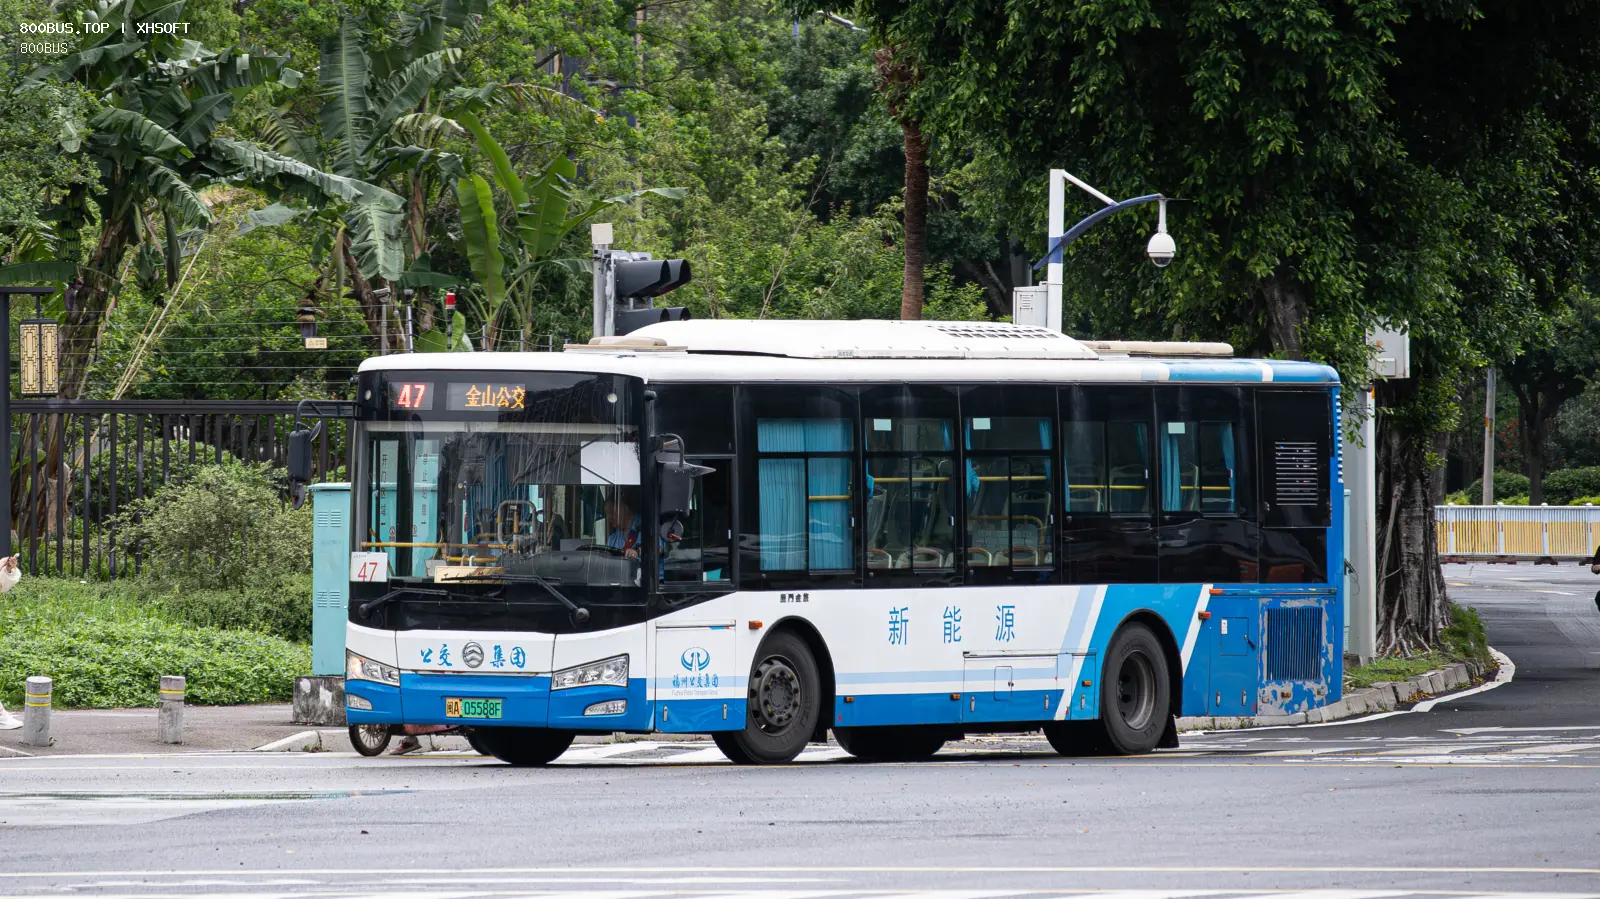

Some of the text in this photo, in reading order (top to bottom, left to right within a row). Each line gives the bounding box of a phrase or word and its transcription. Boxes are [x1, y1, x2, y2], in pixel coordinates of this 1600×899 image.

[397, 384, 426, 408] 47
[464, 384, 526, 409] 金山公交
[357, 561, 379, 582] 47
[888, 604, 1016, 646] 新能源
[420, 643, 526, 669] 公交 集团
